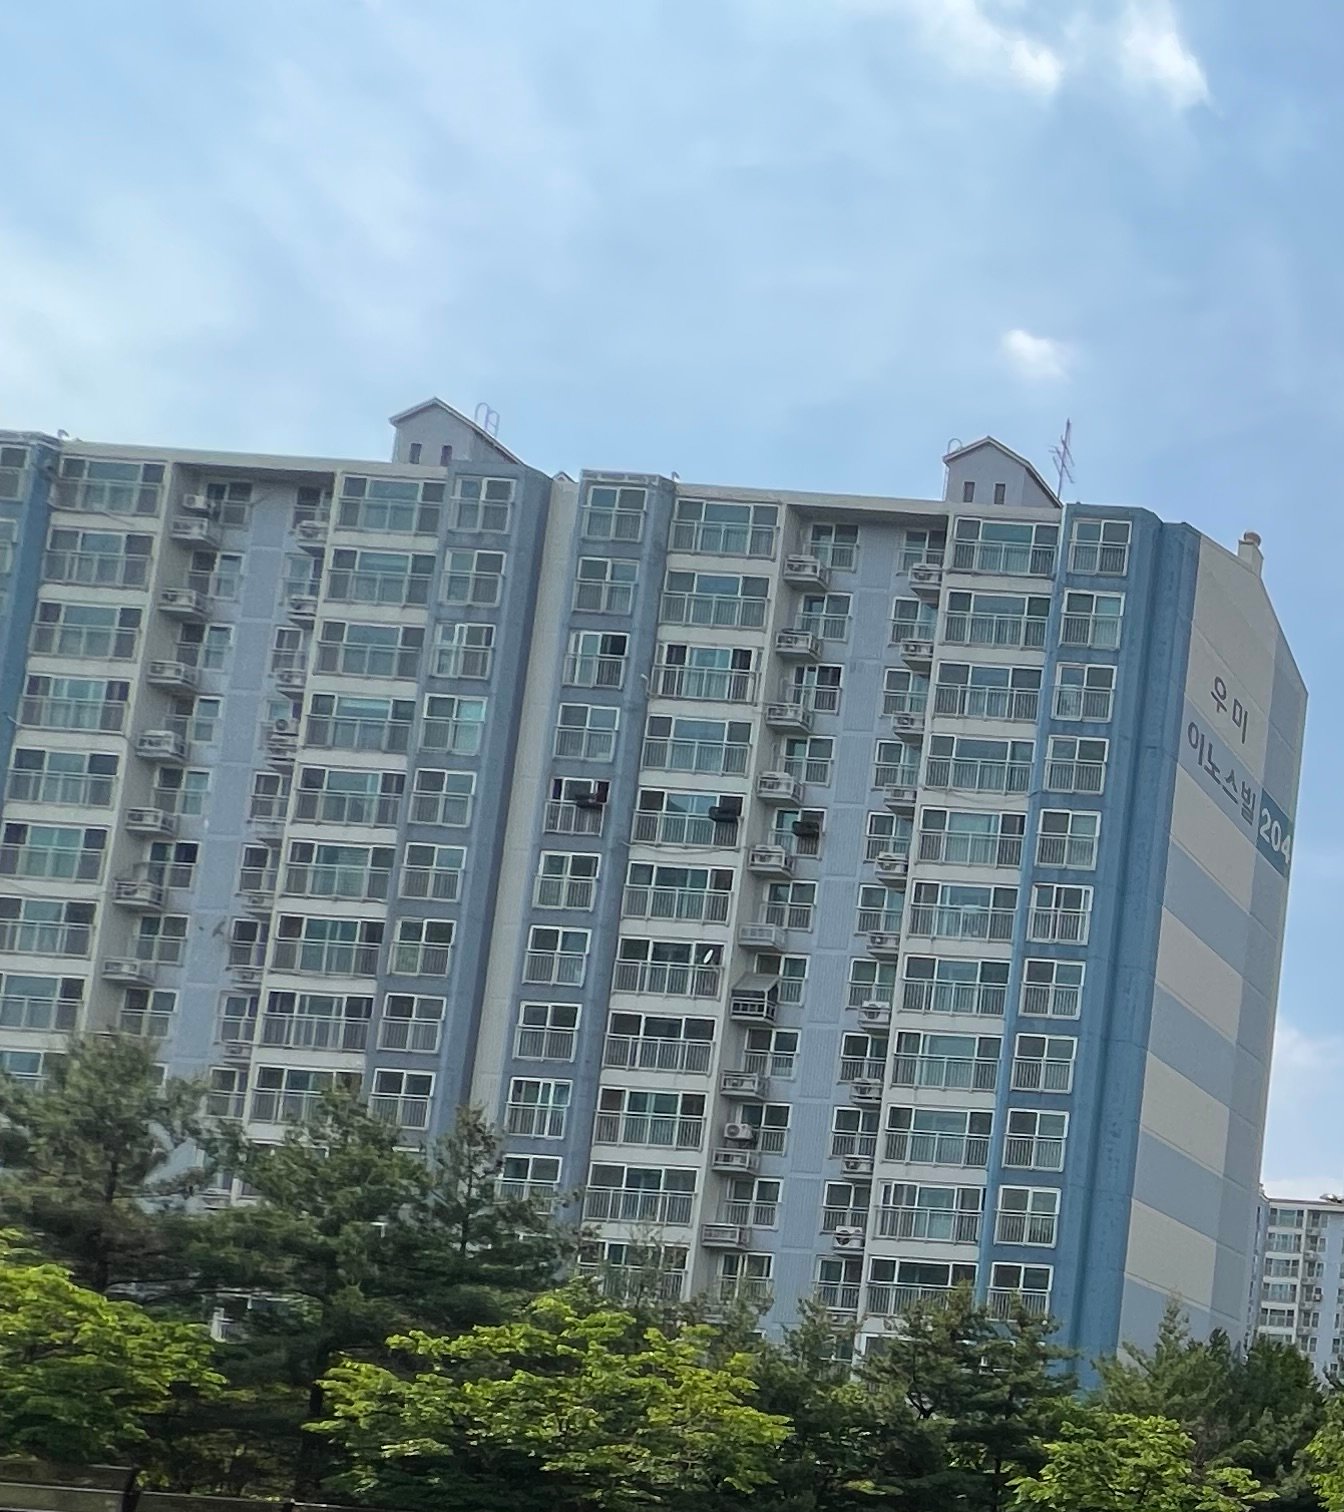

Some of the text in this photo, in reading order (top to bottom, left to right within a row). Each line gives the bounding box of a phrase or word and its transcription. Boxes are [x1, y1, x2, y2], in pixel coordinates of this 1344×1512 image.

[1211, 676, 1248, 744] 우미
[1188, 722, 1256, 826] 이노스빌
[1259, 808, 1291, 864] 204
